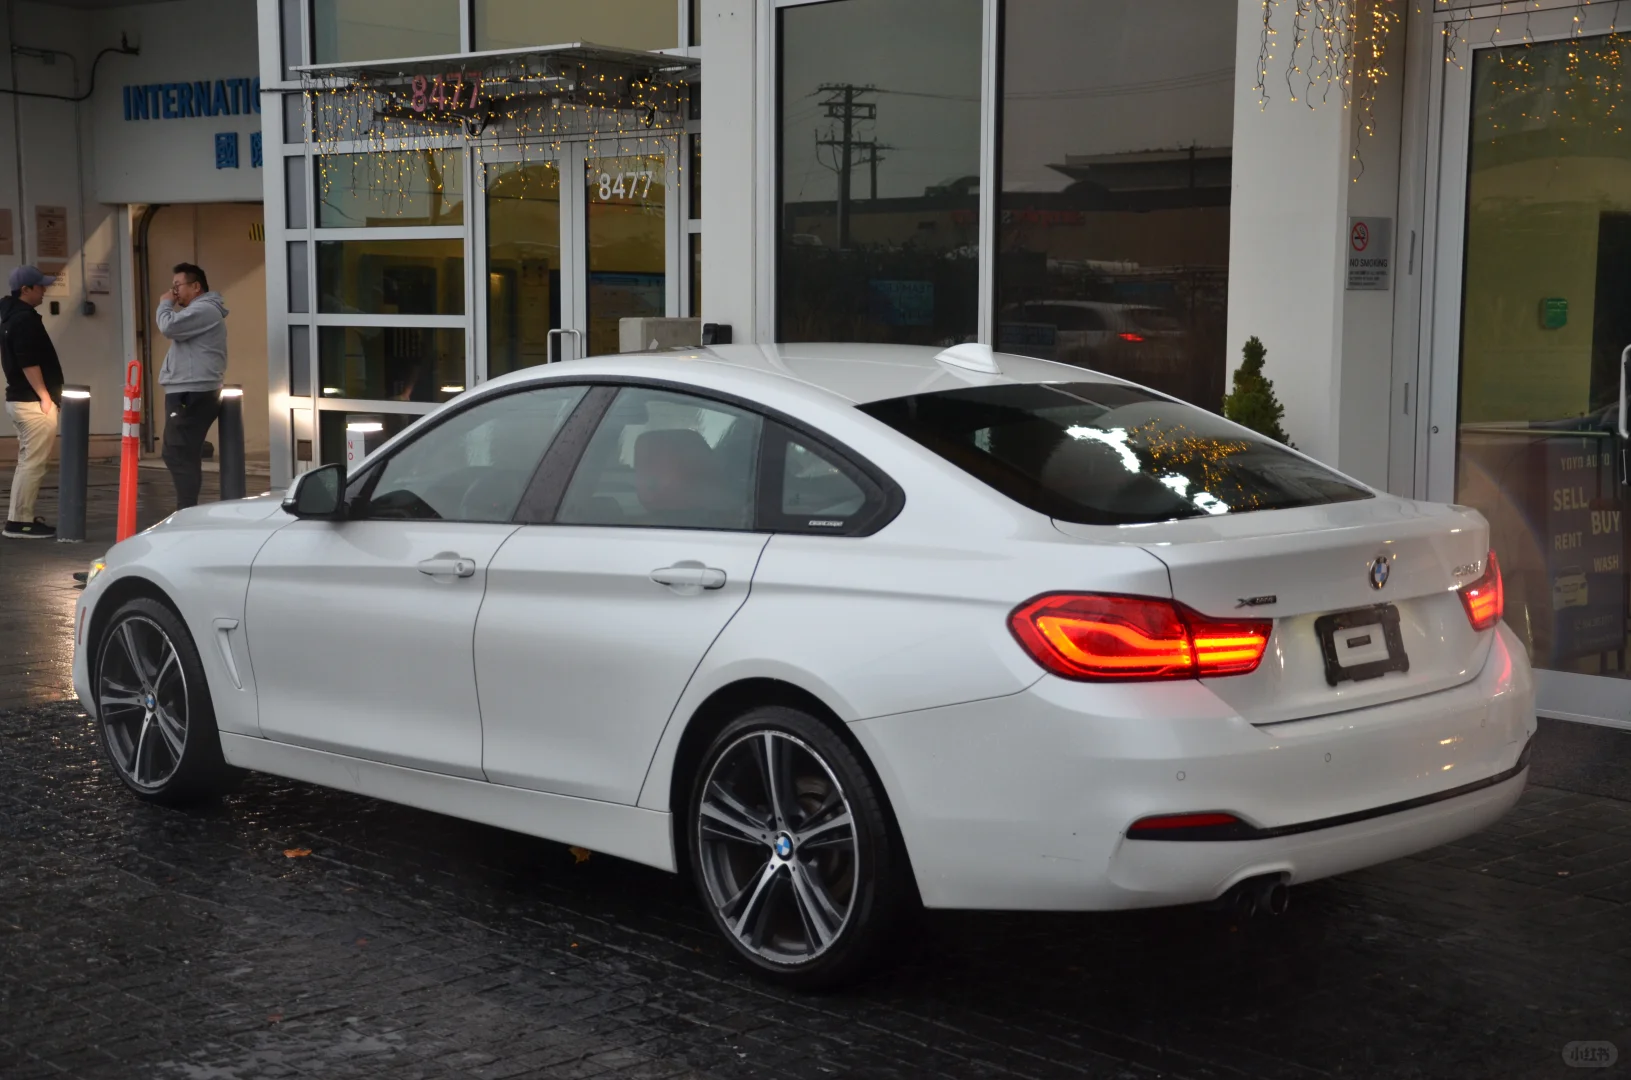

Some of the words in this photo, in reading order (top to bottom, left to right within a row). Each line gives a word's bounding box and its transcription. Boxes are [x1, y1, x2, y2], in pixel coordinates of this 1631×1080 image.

[411, 72, 482, 112] 8477
[598, 171, 653, 200] 8477
[1349, 258, 1359, 267] NO
[1360, 258, 1388, 267] SMOKING
[1560, 456, 1584, 470] YOYO
[1586, 453, 1610, 469] AUO
[1553, 487, 1588, 511] SELL
[1591, 511, 1621, 535] BUY
[1554, 532, 1583, 550] RENT
[1593, 554, 1619, 573] WASH
